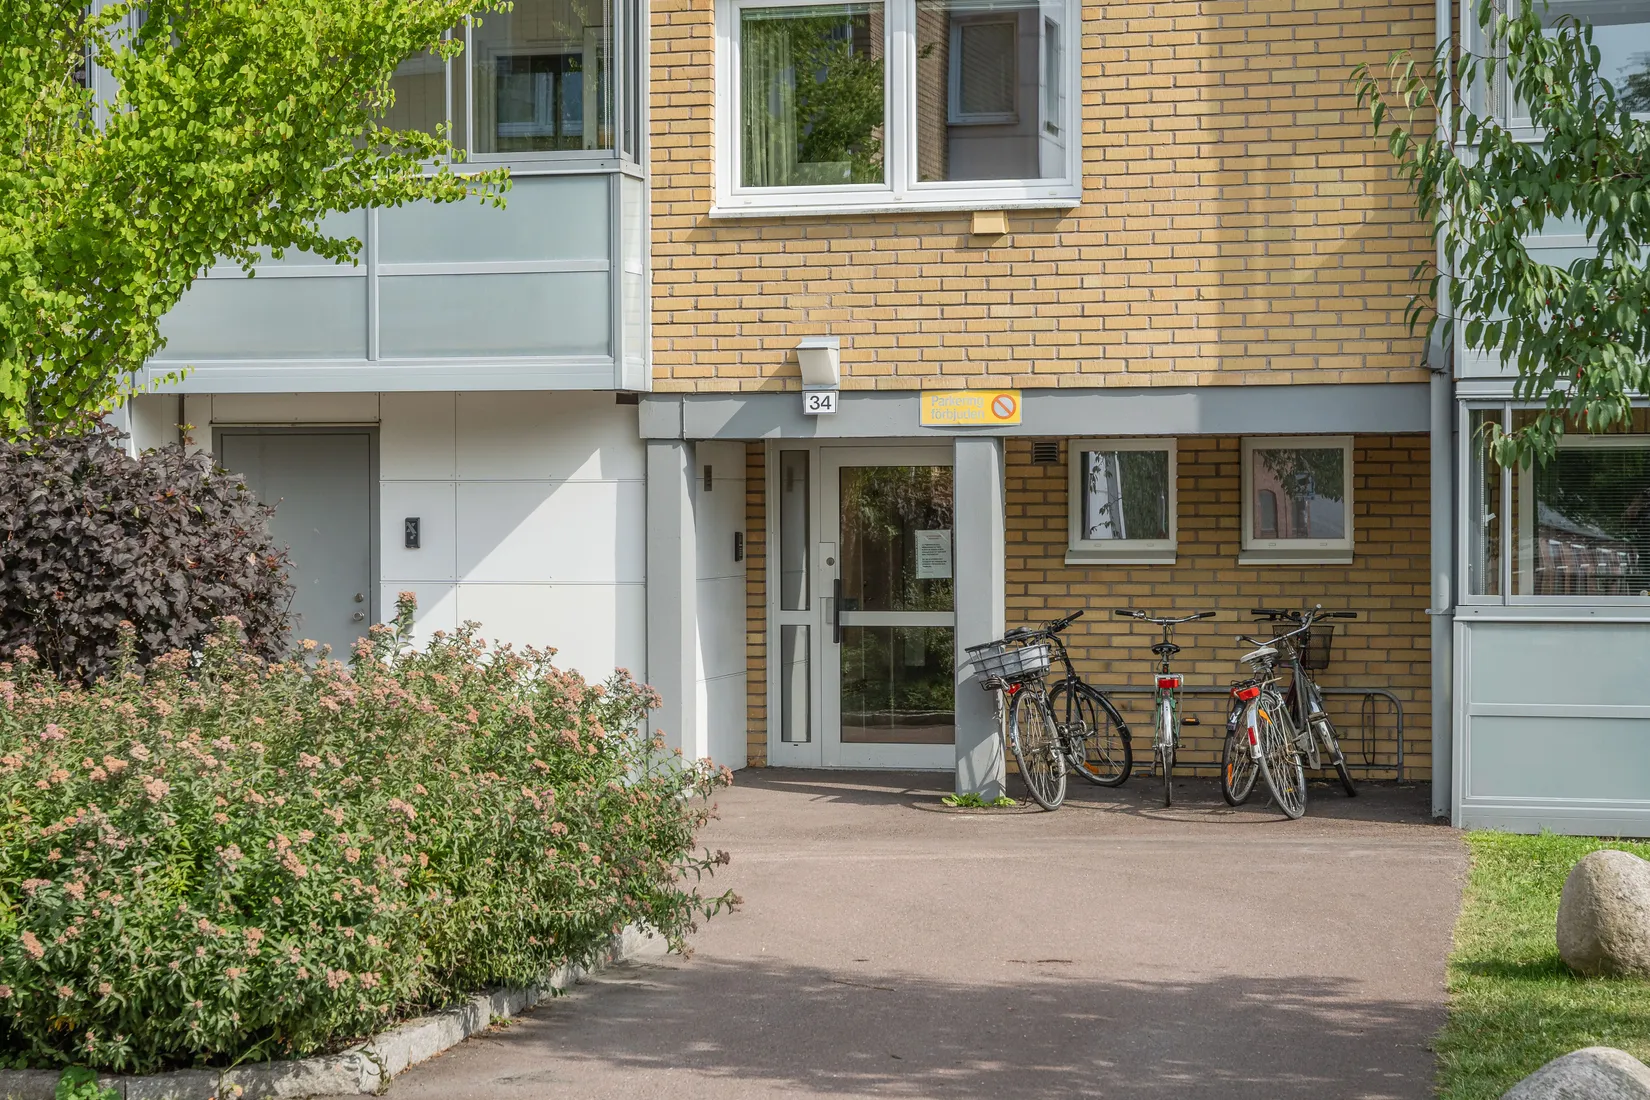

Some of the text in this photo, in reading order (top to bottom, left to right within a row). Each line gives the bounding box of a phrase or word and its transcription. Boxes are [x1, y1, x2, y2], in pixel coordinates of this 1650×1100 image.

[809, 395, 832, 410] 34
[931, 395, 985, 408] Parkering
[931, 408, 985, 421] förbjuden
